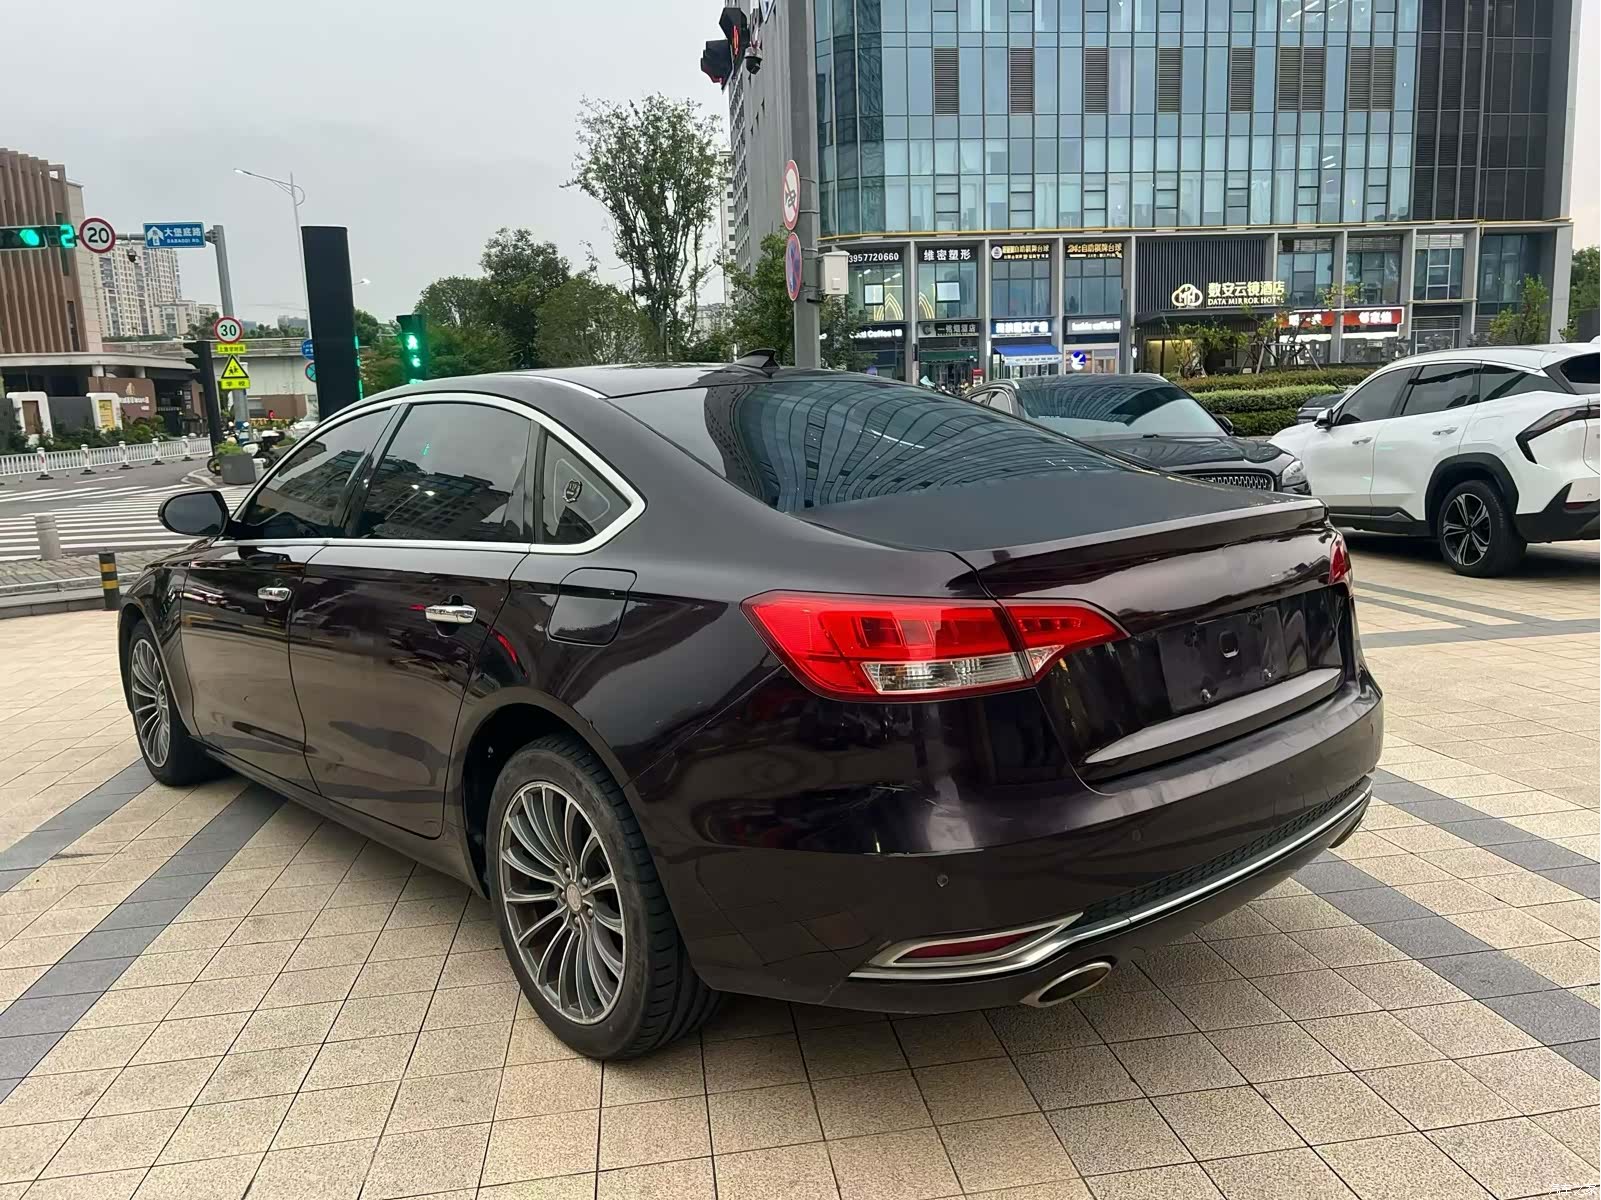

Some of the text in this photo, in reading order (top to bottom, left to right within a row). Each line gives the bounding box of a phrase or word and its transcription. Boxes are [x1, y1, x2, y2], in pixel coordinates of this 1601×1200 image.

[60, 224, 73, 248] 2
[87, 226, 110, 244] 20
[164, 227, 201, 237] 大堡底路
[923, 248, 972, 261] 维密塑形
[1207, 280, 1286, 298] 数安云镜酒店
[1208, 298, 1227, 306] DATA
[1228, 297, 1259, 305] MIRROR
[220, 324, 237, 336] 30
